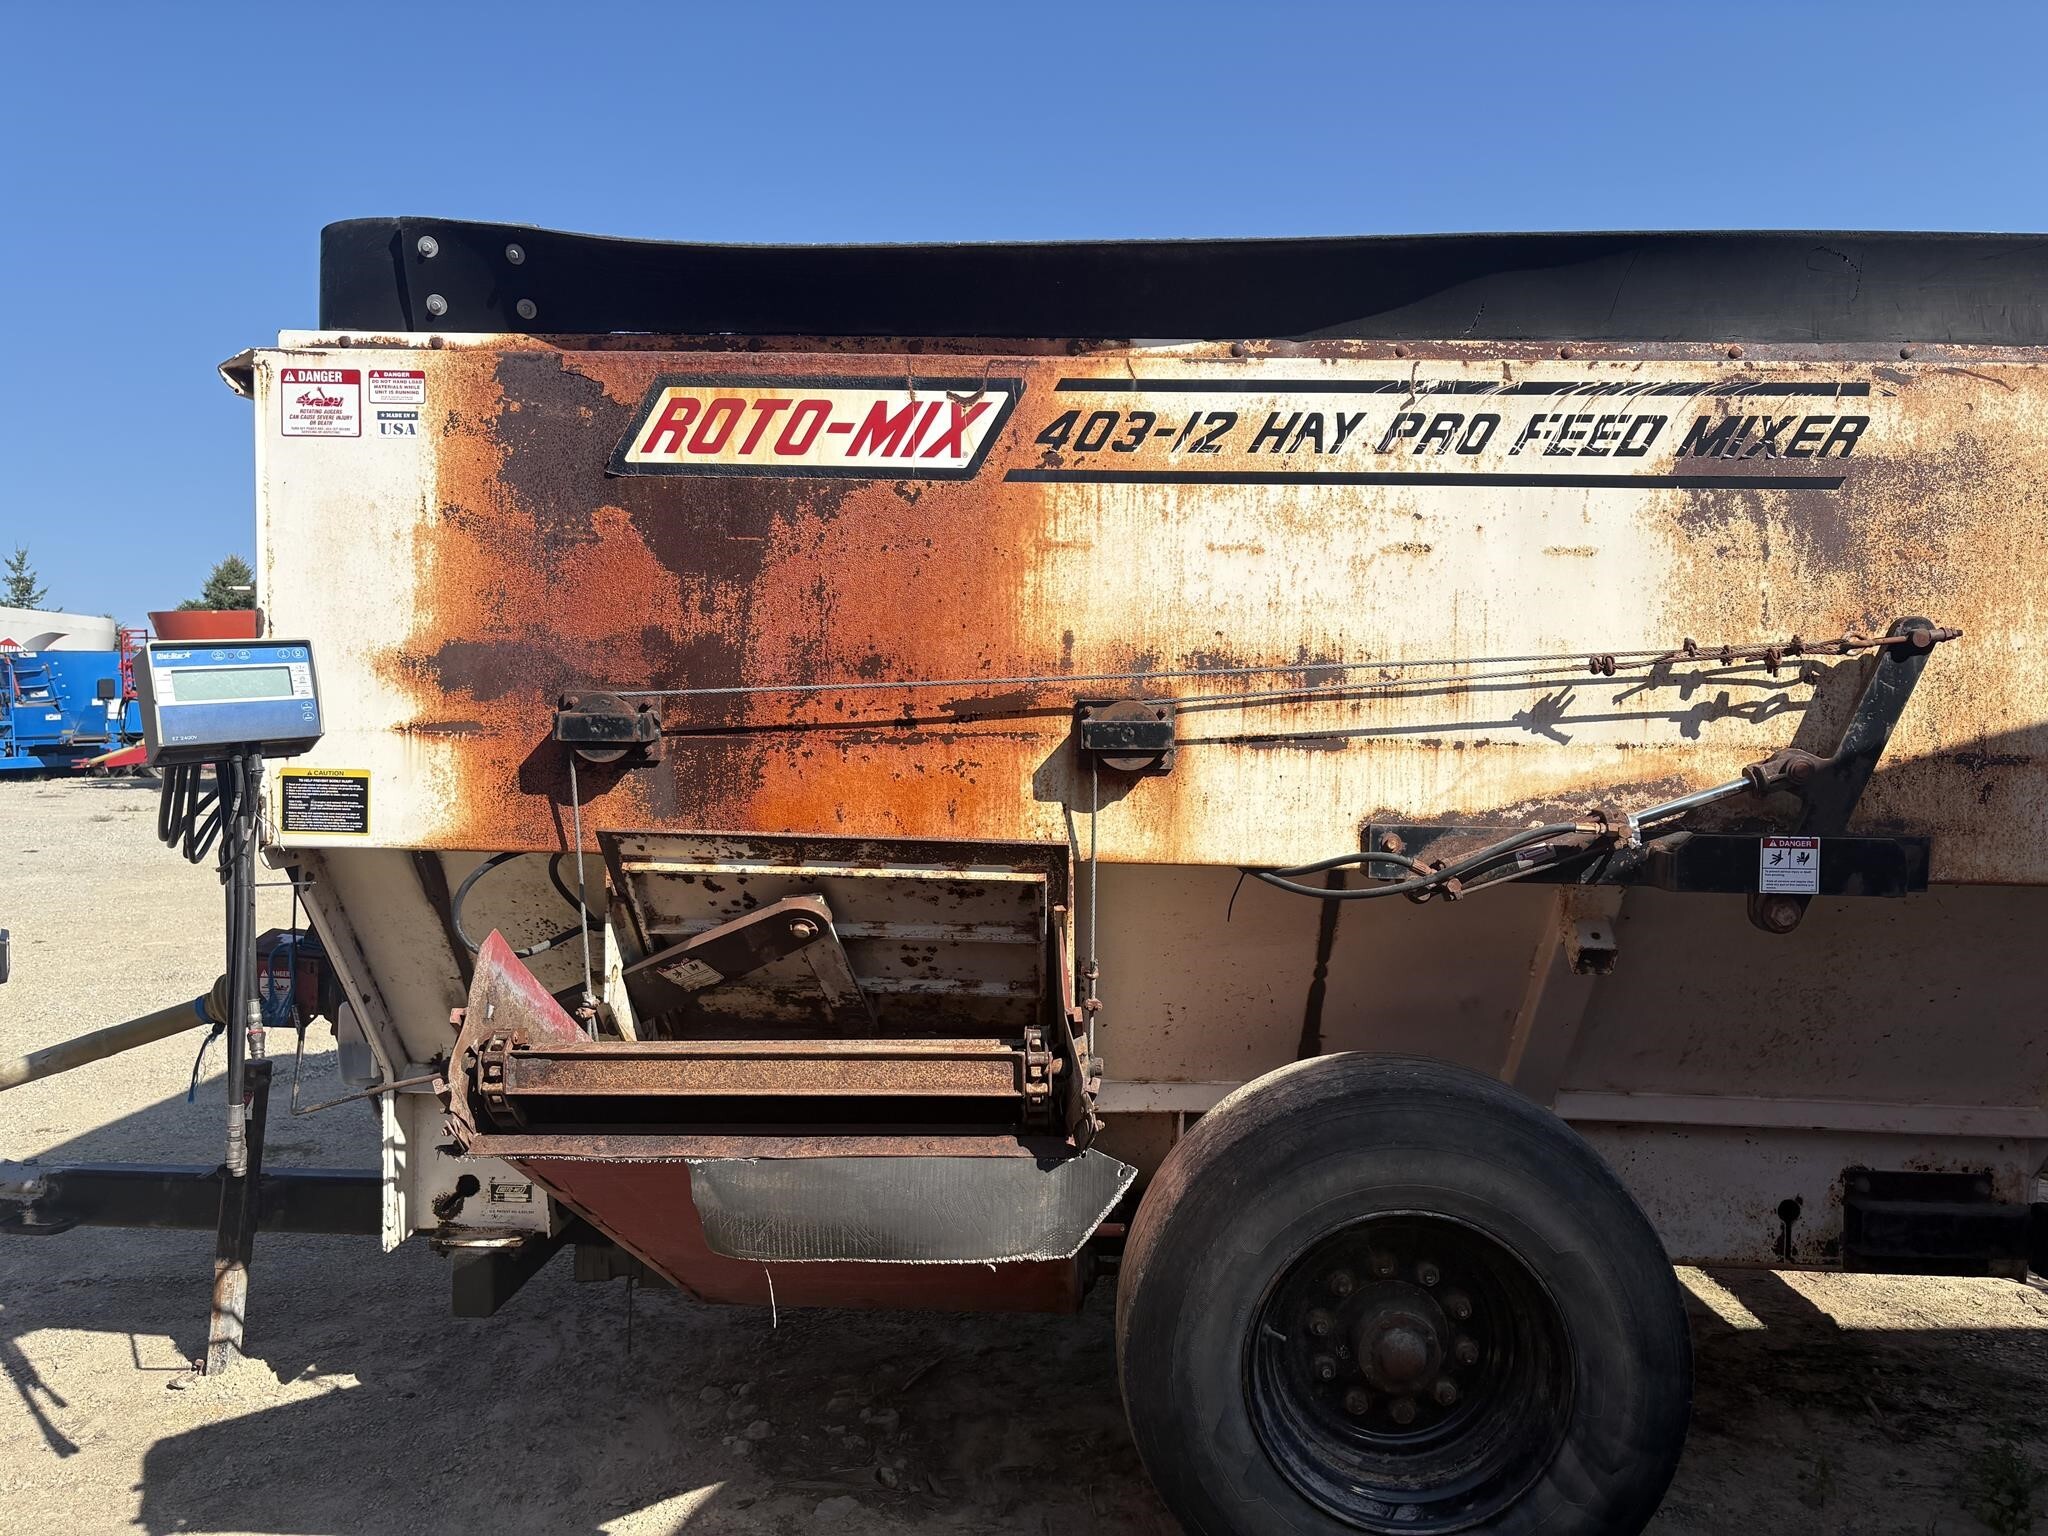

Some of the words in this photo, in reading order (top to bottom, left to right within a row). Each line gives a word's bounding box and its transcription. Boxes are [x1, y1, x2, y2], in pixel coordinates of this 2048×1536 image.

[298, 370, 343, 382] DANGER
[380, 422, 416, 435] USA
[640, 396, 994, 459] ROTO-MIX
[1034, 409, 1239, 455] 403-12
[1247, 411, 1368, 455] HAY
[1376, 411, 1501, 455] PRO
[1508, 413, 1669, 457] FEED
[1674, 414, 1871, 459] MIXER
